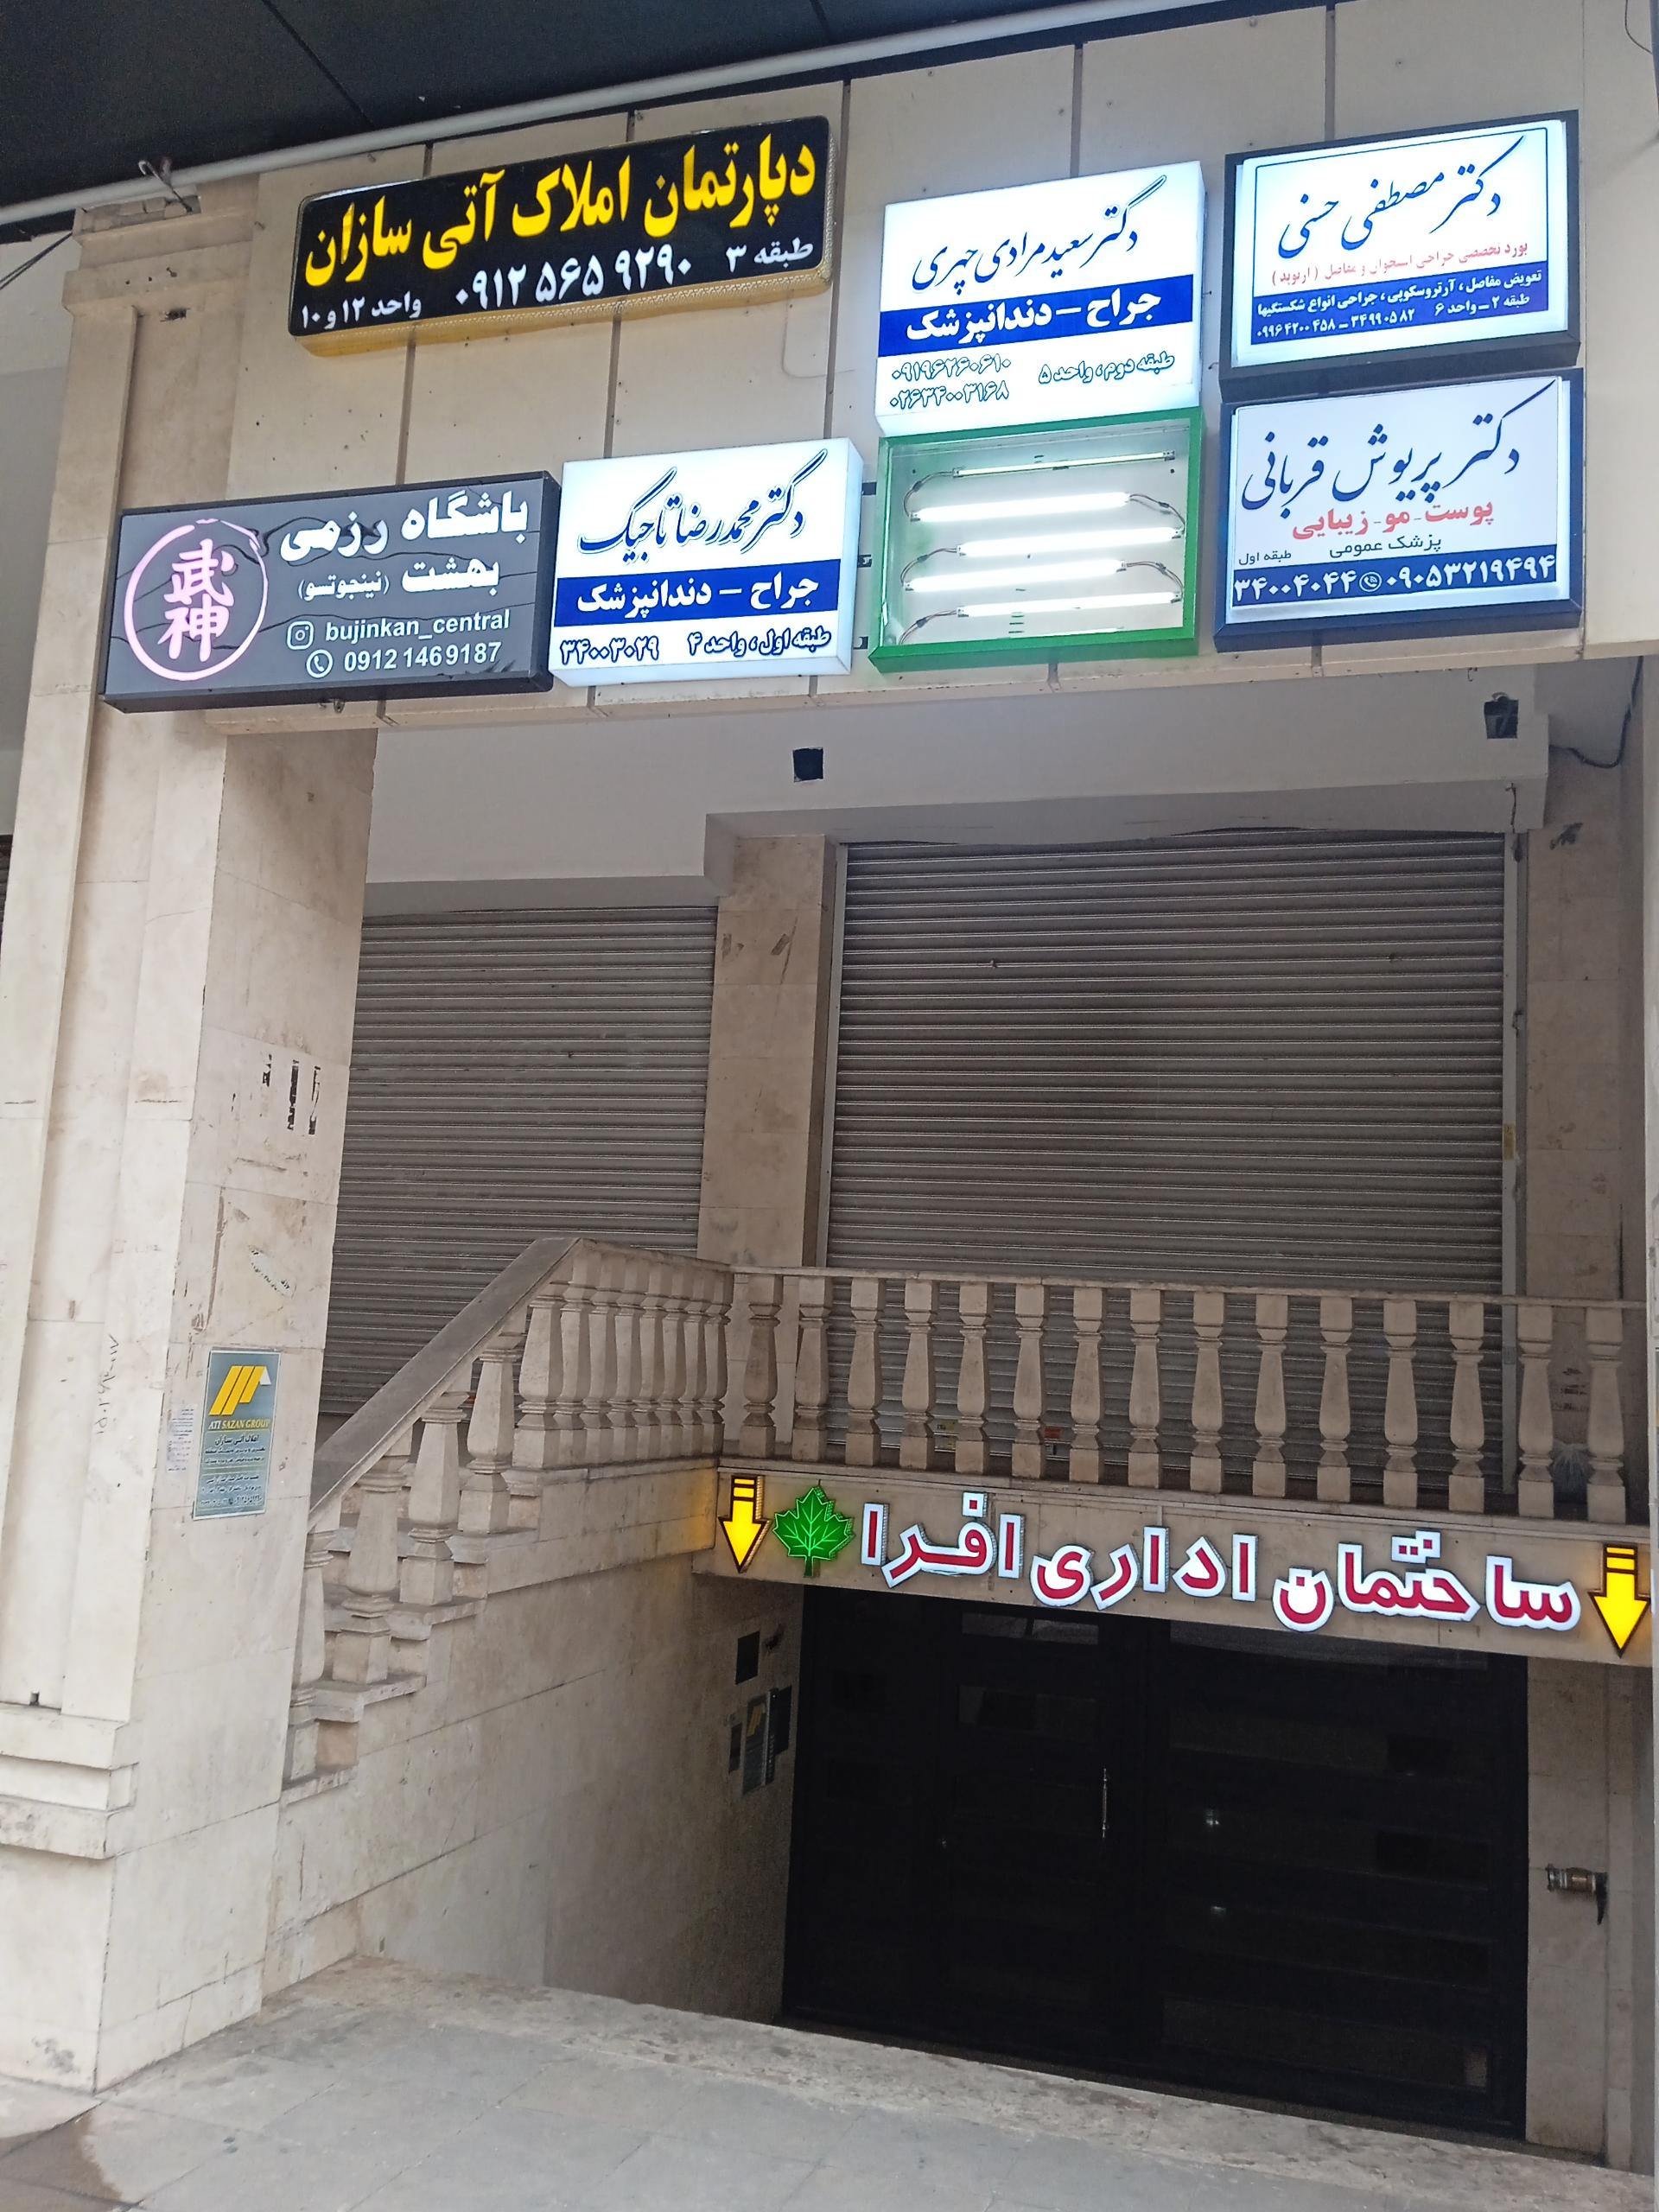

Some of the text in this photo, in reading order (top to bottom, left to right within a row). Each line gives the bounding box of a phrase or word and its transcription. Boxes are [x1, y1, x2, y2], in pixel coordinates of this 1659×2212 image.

[305, 133, 816, 287] دپارتمان املاک آتی سازان
[1278, 135, 1526, 259] دکتر مصطفی حسنی
[1079, 175, 1166, 270] دکتر
[725, 237, 814, 273] طبقه ۳
[975, 232, 1046, 283] مرادی
[1041, 232, 1093, 278] سعید
[1416, 251, 1454, 269] جراحی
[1504, 243, 1528, 257] بورد
[455, 244, 692, 310] ۰۹۱۲ ۵۶۵ ۹۲۹۰
[1503, 270, 1542, 289] تعویض
[371, 290, 422, 319] واحد
[1086, 288, 1161, 327] جراح
[1257, 300, 1306, 317] شکستگیها
[1307, 295, 1336, 312] انواع
[1337, 291, 1378, 308] جراحی
[1434, 302, 1445, 316] ۶
[1447, 300, 1477, 315] واحد
[1491, 295, 1500, 308] ۲
[1503, 293, 1530, 308] طبقه
[906, 299, 1052, 344] دندانپزشک
[892, 353, 1012, 382] ۰۹۱۹۶۲۶۰۶۱۰
[1039, 364, 1052, 384] ۵
[1053, 360, 1093, 383] واحد
[1136, 351, 1175, 374] طبقه
[890, 380, 1009, 410] ۰۲۶۳۴۰۰۳۱۶۸
[1241, 378, 1556, 519] دکتر پریوش قربانی
[577, 466, 683, 565] تاجیک
[740, 448, 828, 554] دکتر
[1425, 501, 1494, 526] پوست
[280, 490, 528, 562] باشگاه رزمی
[1292, 508, 1369, 540] زیبایی
[1382, 511, 1410, 533] مو
[1238, 550, 1292, 565] طبقه اول
[1329, 534, 1441, 558] پزشک عمومی
[298, 557, 499, 601] بهشت (نینجوتسو)
[750, 571, 819, 610] جراح
[1233, 554, 1556, 601] ۳۴۰۰۴۰۴۴ ۰۹۰۵۳۲۱۹۴۹۴
[156, 537, 236, 663] 武神
[577, 576, 713, 620] دندانپزشک
[325, 608, 510, 645] bujinkan_central
[791, 625, 832, 654] طبقه
[560, 635, 659, 665] ۳۴۰۰۳۰۲۹
[687, 632, 702, 657] ۴
[704, 630, 747, 658] واحد
[861, 1491, 1581, 1632] ساختمان اداری افرا
